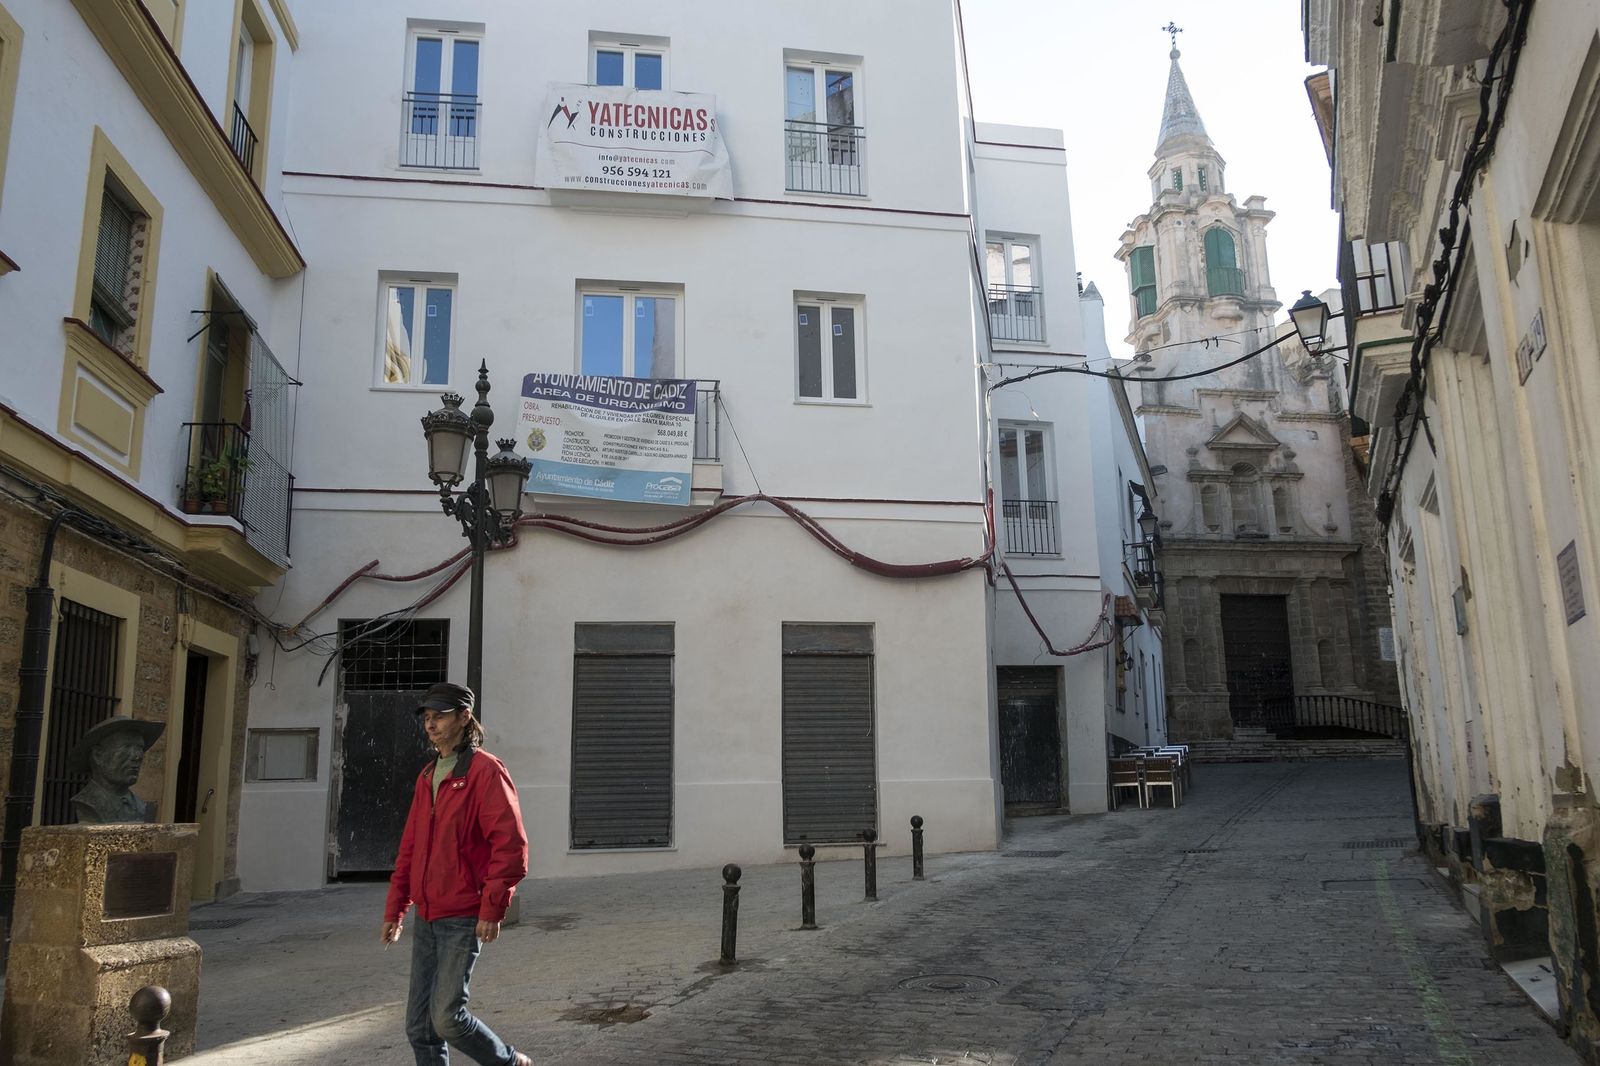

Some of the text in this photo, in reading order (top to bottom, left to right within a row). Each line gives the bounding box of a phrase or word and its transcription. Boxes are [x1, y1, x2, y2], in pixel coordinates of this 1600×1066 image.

[588, 101, 708, 131] YATECNICAS
[590, 126, 706, 142] CONSTRUCCIONES
[598, 153, 675, 165] info@yatecnicas.com
[602, 165, 671, 179] 956 594 121
[564, 175, 707, 190] www.construccionesyatecnicas.com
[634, 382, 651, 399] DE
[532, 387, 686, 410] AREA DE URBANIMO
[665, 414, 690, 422] ESPECIAL
